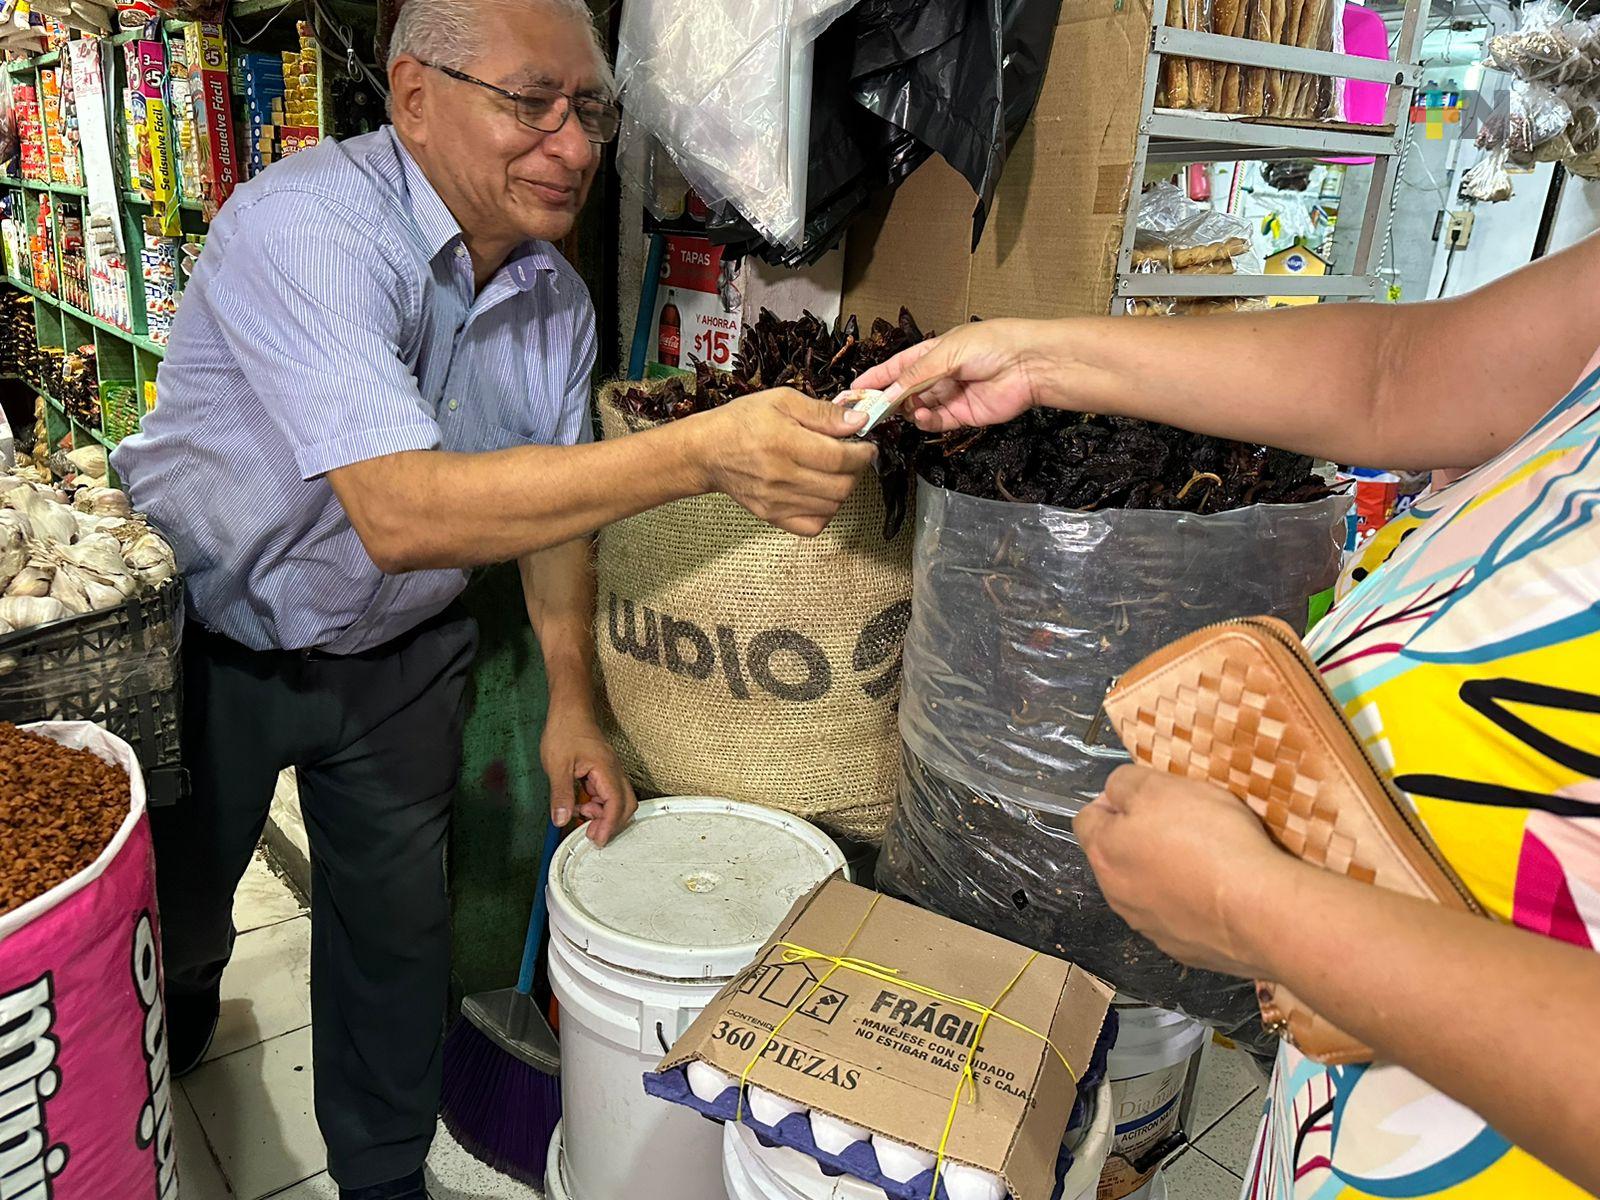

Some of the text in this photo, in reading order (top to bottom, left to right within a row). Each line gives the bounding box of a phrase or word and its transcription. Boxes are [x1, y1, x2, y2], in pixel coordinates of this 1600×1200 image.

[143, 54, 151, 66] 3
[145, 70, 162, 87] $5
[215, 114, 231, 163] disuelve
[156, 135, 169, 176] disuelve
[160, 177, 171, 191] Se
[221, 167, 233, 184] Se
[680, 250, 711, 266] TAPAS
[695, 313, 737, 330] Y AHORRA
[870, 990, 985, 1053] FRÁGIL
[861, 1017, 926, 1048] MANÉJESE
[928, 1043, 955, 1059] CON
[711, 1020, 861, 1090] 360 PIEZAS
[855, 1027, 873, 1040] NO
[876, 1034, 928, 1062] ESTIBAR
[930, 1055, 960, 1073] MÁS
[982, 1075, 992, 1085] 5
